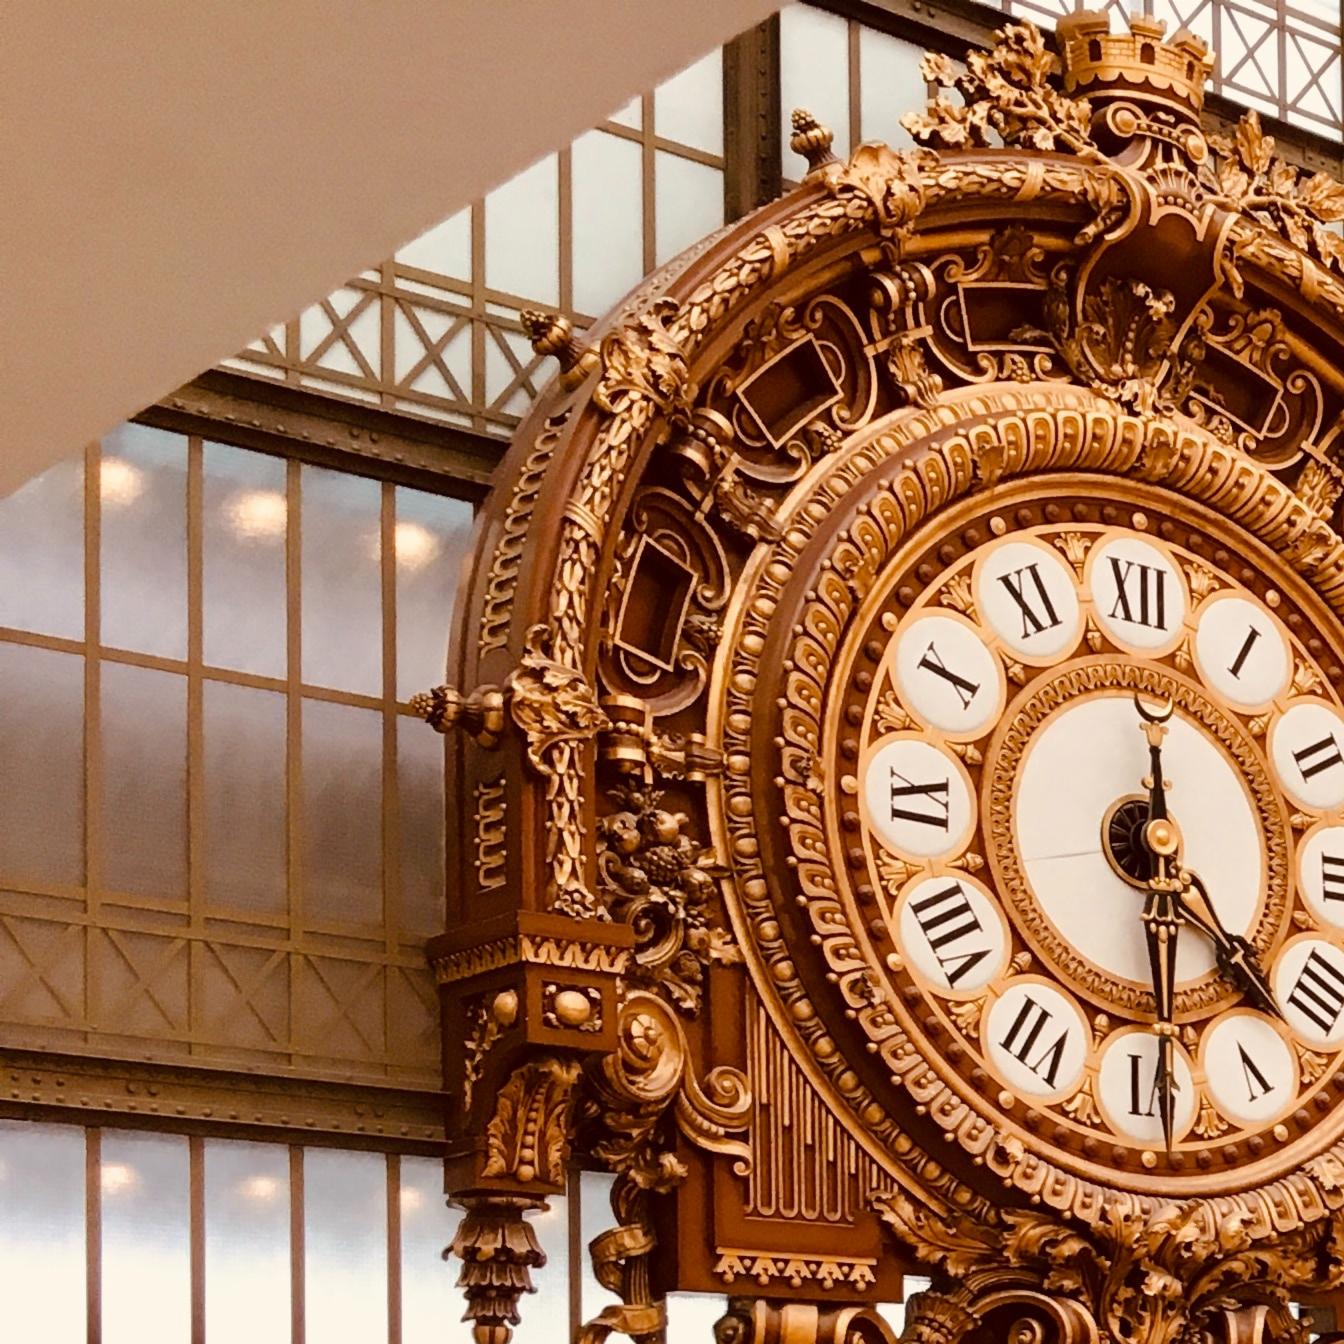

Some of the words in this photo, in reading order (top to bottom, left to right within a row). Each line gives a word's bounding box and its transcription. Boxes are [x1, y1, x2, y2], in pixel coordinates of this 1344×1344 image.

[997, 563, 1062, 639] XI
[1106, 555, 1168, 631] XII
[917, 641, 980, 710] X
[1292, 731, 1344, 783] II
[890, 766, 949, 833] IX
[908, 881, 993, 989] VIII
[999, 994, 1071, 1090] VII
[1237, 1041, 1275, 1102] V
